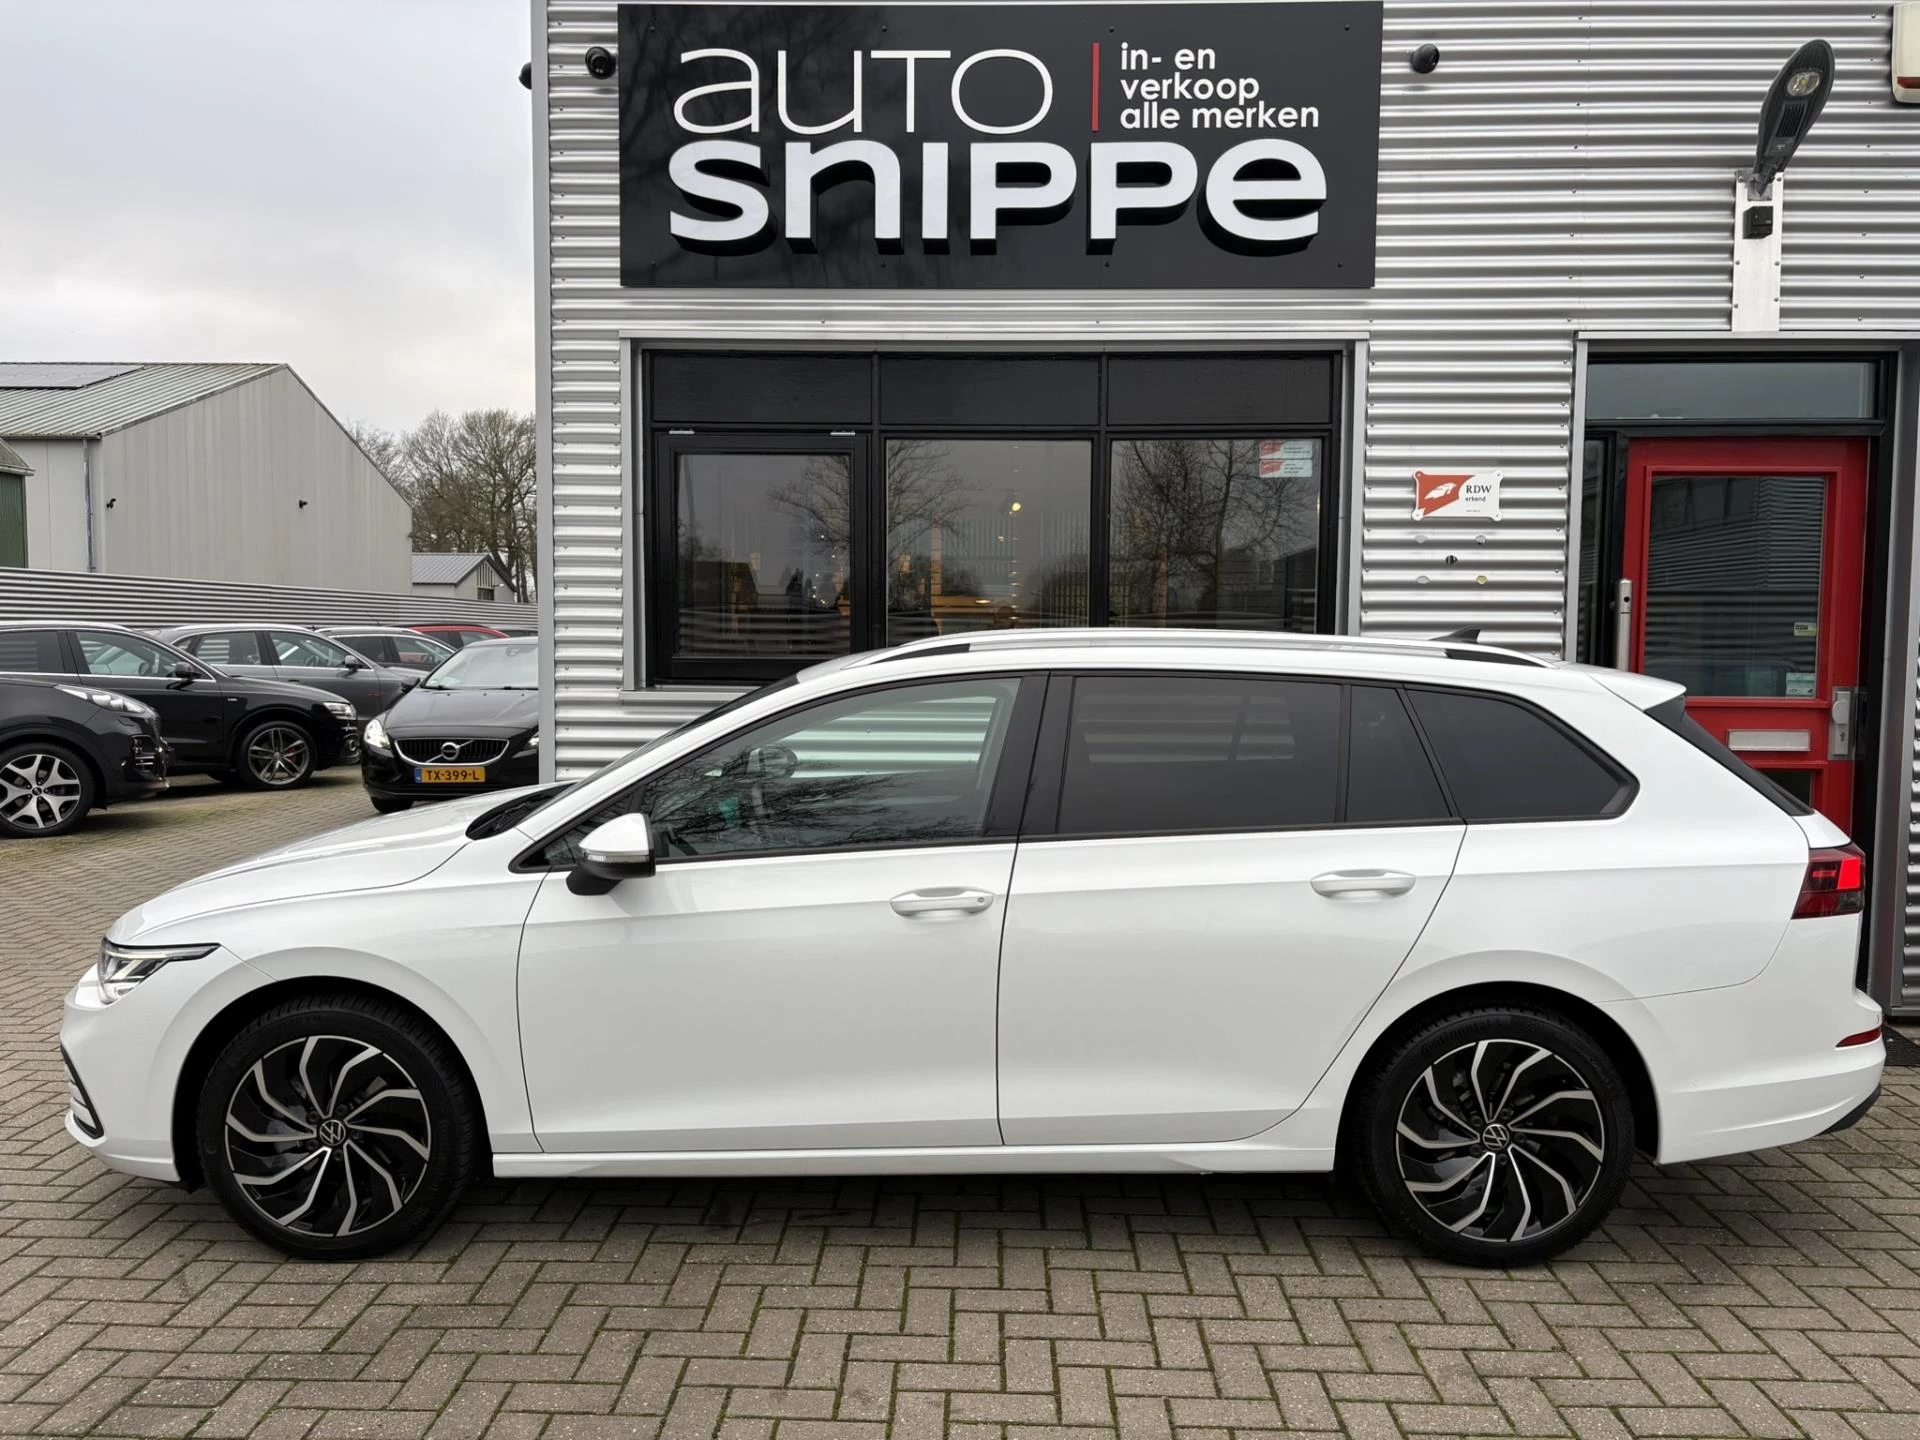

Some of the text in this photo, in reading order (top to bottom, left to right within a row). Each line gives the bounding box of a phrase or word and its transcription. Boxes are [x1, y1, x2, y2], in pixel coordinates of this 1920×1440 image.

[1120, 41, 1216, 71] in- en
[1120, 71, 1260, 106] verkoop
[1120, 100, 1320, 130] alle merken
[1466, 485, 1492, 494] RDW
[427, 770, 480, 781] TX-399-L
